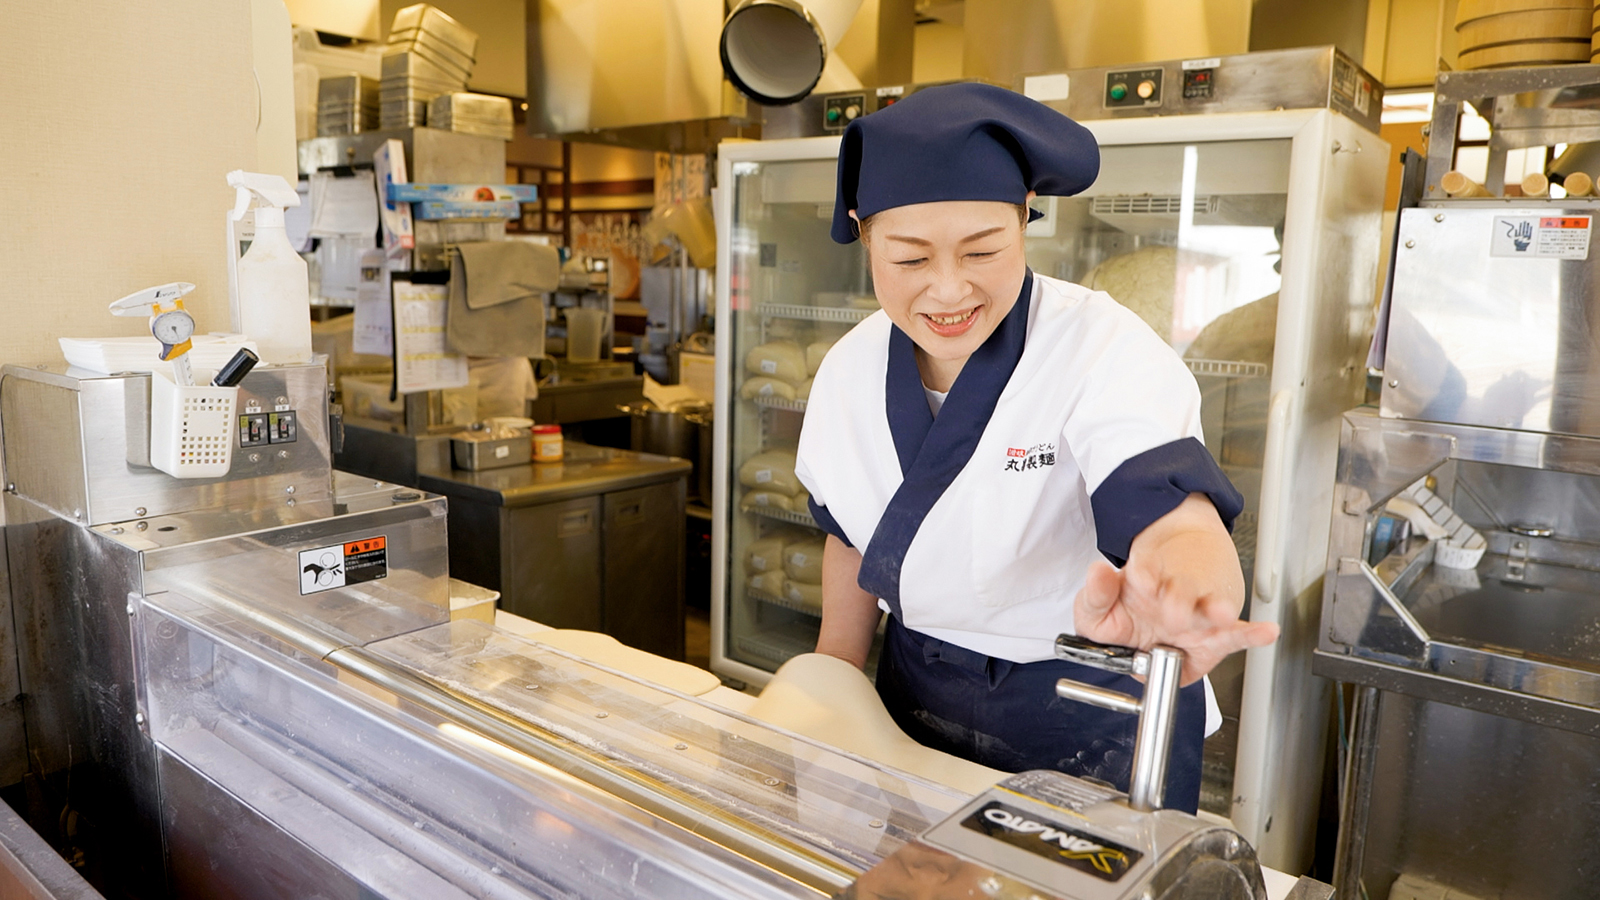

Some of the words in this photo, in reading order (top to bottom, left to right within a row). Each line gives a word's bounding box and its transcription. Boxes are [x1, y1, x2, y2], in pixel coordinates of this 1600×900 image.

[1004, 452, 1056, 472] 丸製麺
[983, 808, 1129, 874] YAMATO
